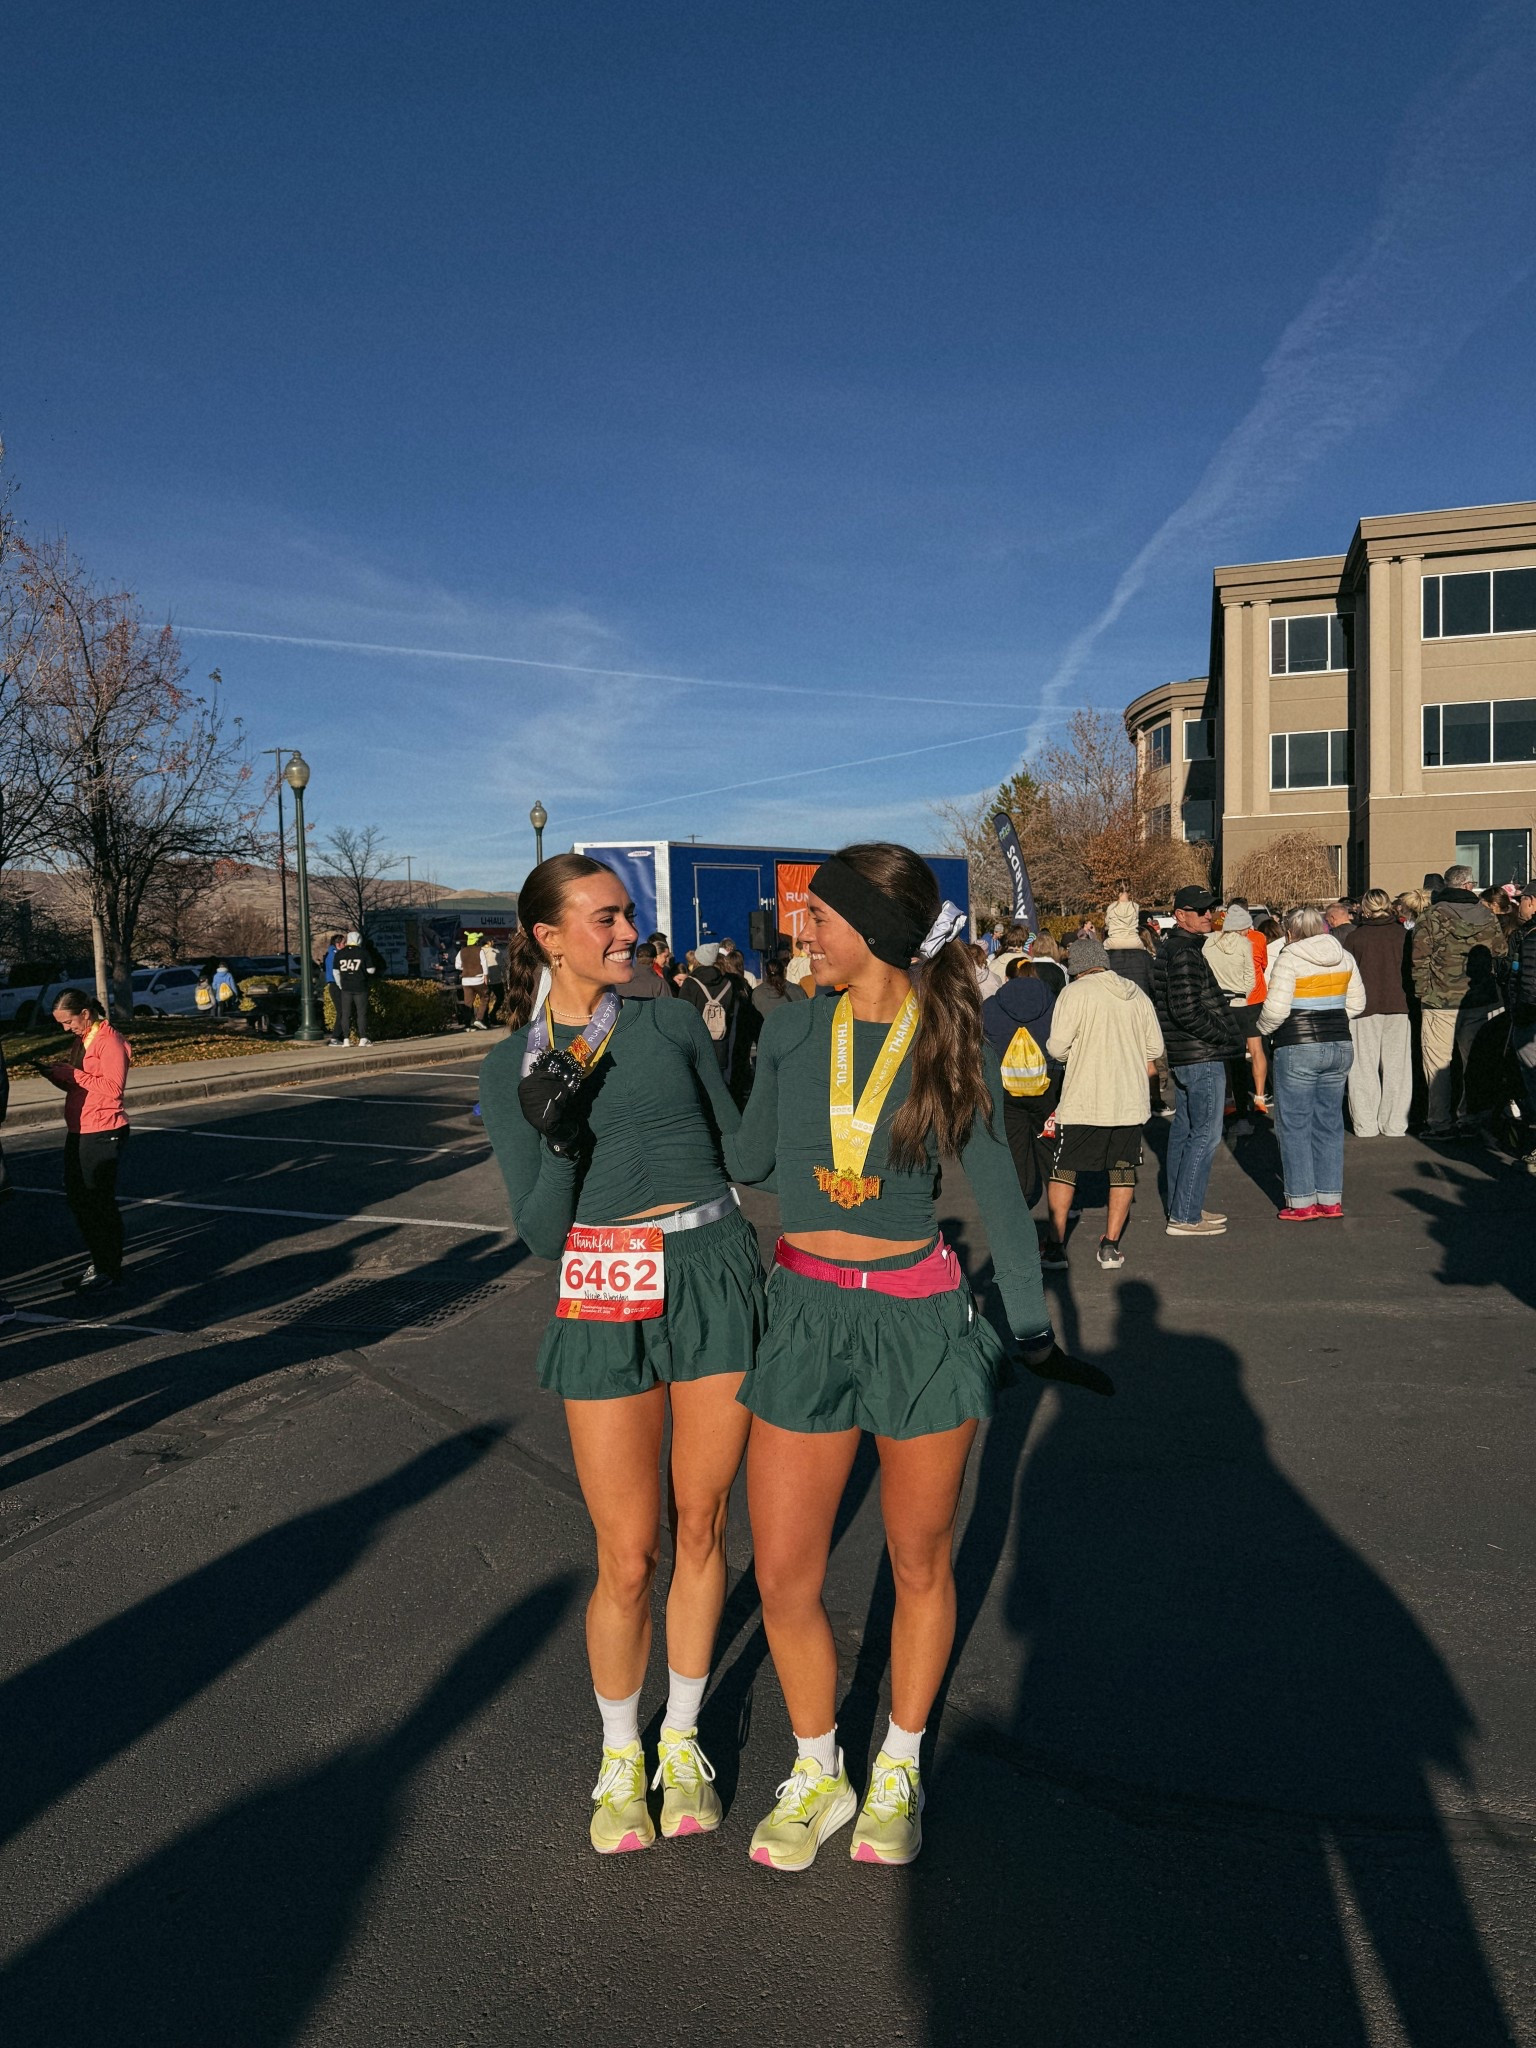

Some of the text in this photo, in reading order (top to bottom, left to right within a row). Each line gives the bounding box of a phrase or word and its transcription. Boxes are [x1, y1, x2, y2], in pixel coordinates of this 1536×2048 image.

[1006, 844, 1029, 920] AWARDS
[480, 916, 506, 925] U-HAUL
[339, 958, 361, 972] 247
[836, 1021, 849, 1088] THANKFUL
[569, 1231, 647, 1252] Thankful 5K
[564, 1258, 658, 1292] 6462
